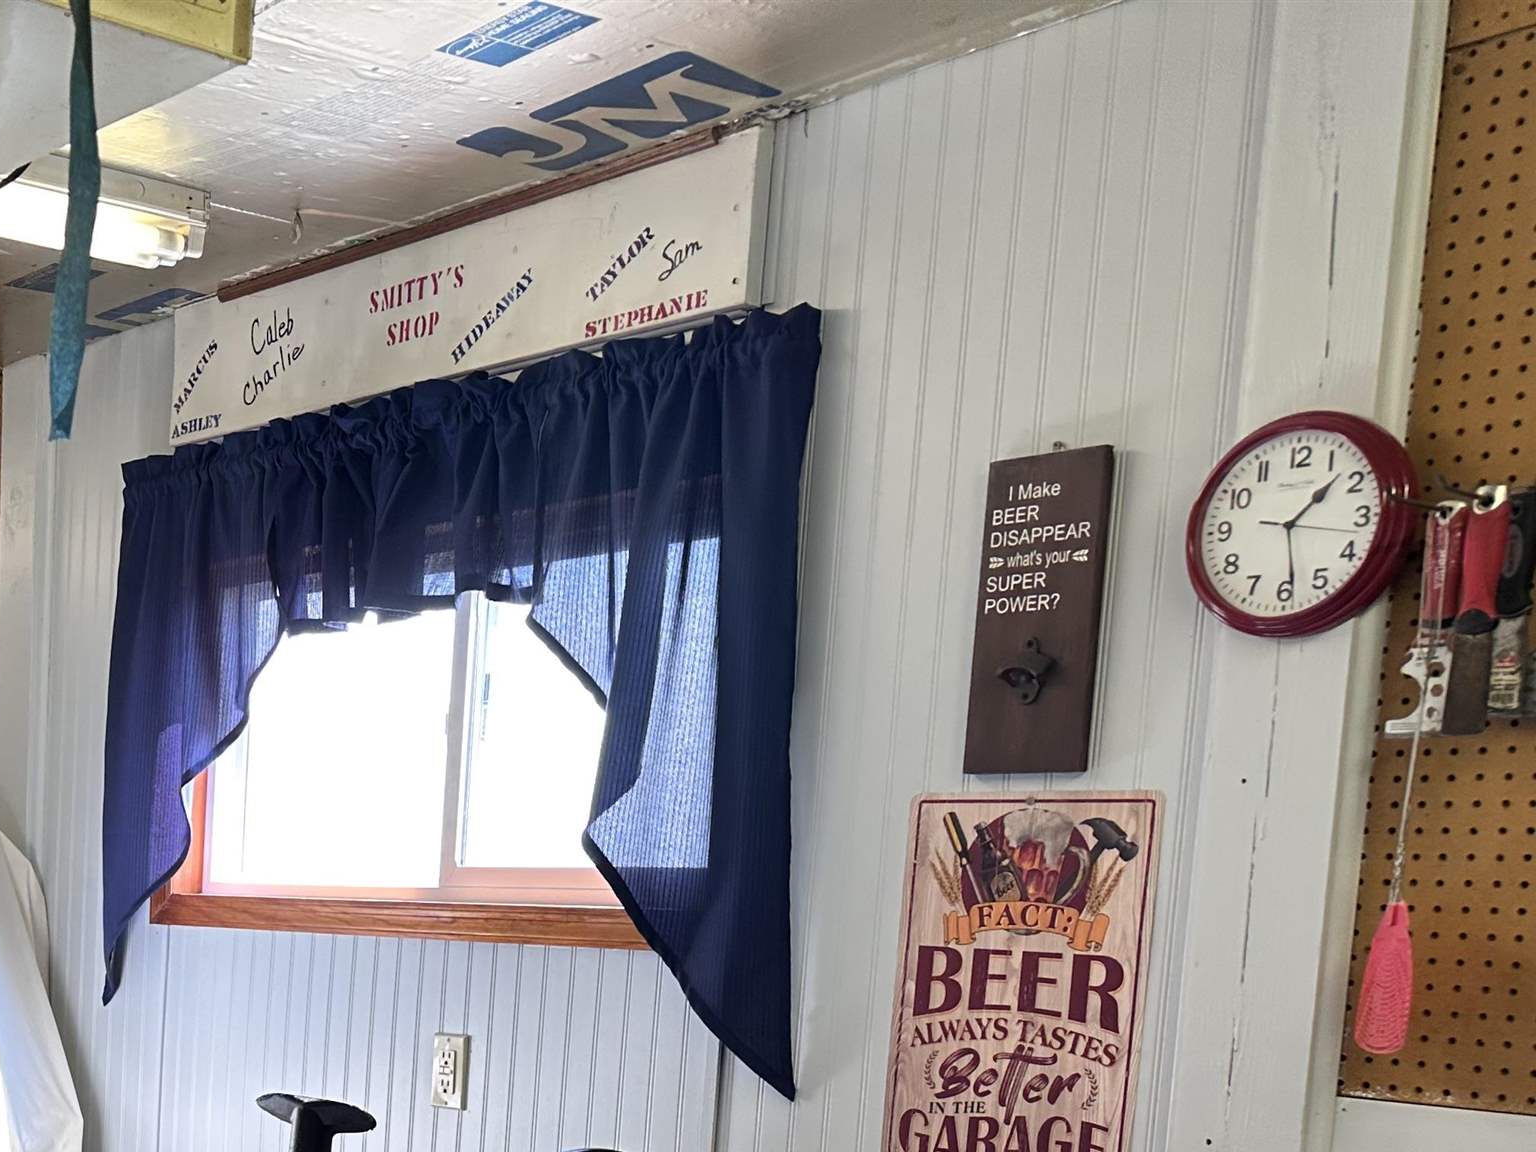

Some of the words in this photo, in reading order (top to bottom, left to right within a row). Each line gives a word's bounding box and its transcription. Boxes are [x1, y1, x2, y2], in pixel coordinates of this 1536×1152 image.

[586, 226, 655, 302] TAYLOR
[657, 239, 703, 281] Sam
[369, 265, 465, 314] SMITTY'S
[450, 267, 535, 365] HIDEAWAY
[585, 289, 709, 338] STEPHANIE
[251, 307, 294, 355] Caleb
[386, 311, 440, 347] SHOP
[173, 339, 218, 414] MARCUS
[243, 344, 305, 406] Charlie
[171, 413, 223, 439] ASHLEY
[1290, 446, 1313, 469] 12
[1328, 450, 1335, 471] 1
[1257, 460, 1270, 482] 11
[1347, 471, 1364, 493] 2
[1008, 485, 1014, 501] I
[1018, 481, 1061, 501] Make
[1230, 488, 1252, 510] 10
[992, 505, 1040, 526] BEER
[1353, 505, 1371, 527] 3
[990, 521, 1092, 548] DISAPPEAR
[1217, 521, 1233, 542] 9
[1007, 550, 1043, 568] what's
[1045, 550, 1071, 568] your
[1339, 540, 1356, 562] 4
[1223, 553, 1239, 574] 8
[985, 571, 1046, 593] SUPER
[1247, 575, 1262, 595] 7
[1312, 568, 1329, 589] 5
[1276, 580, 1294, 602] 6
[984, 593, 1061, 615] POWER?
[978, 903, 1073, 933] FACT:
[913, 945, 1125, 1034] BEER
[910, 1017, 1009, 1048] ALWAYS
[1016, 1019, 1119, 1067] TASTES
[934, 1044, 1082, 1125] Better
[928, 1101, 946, 1115] IN
[952, 1101, 986, 1114] THE
